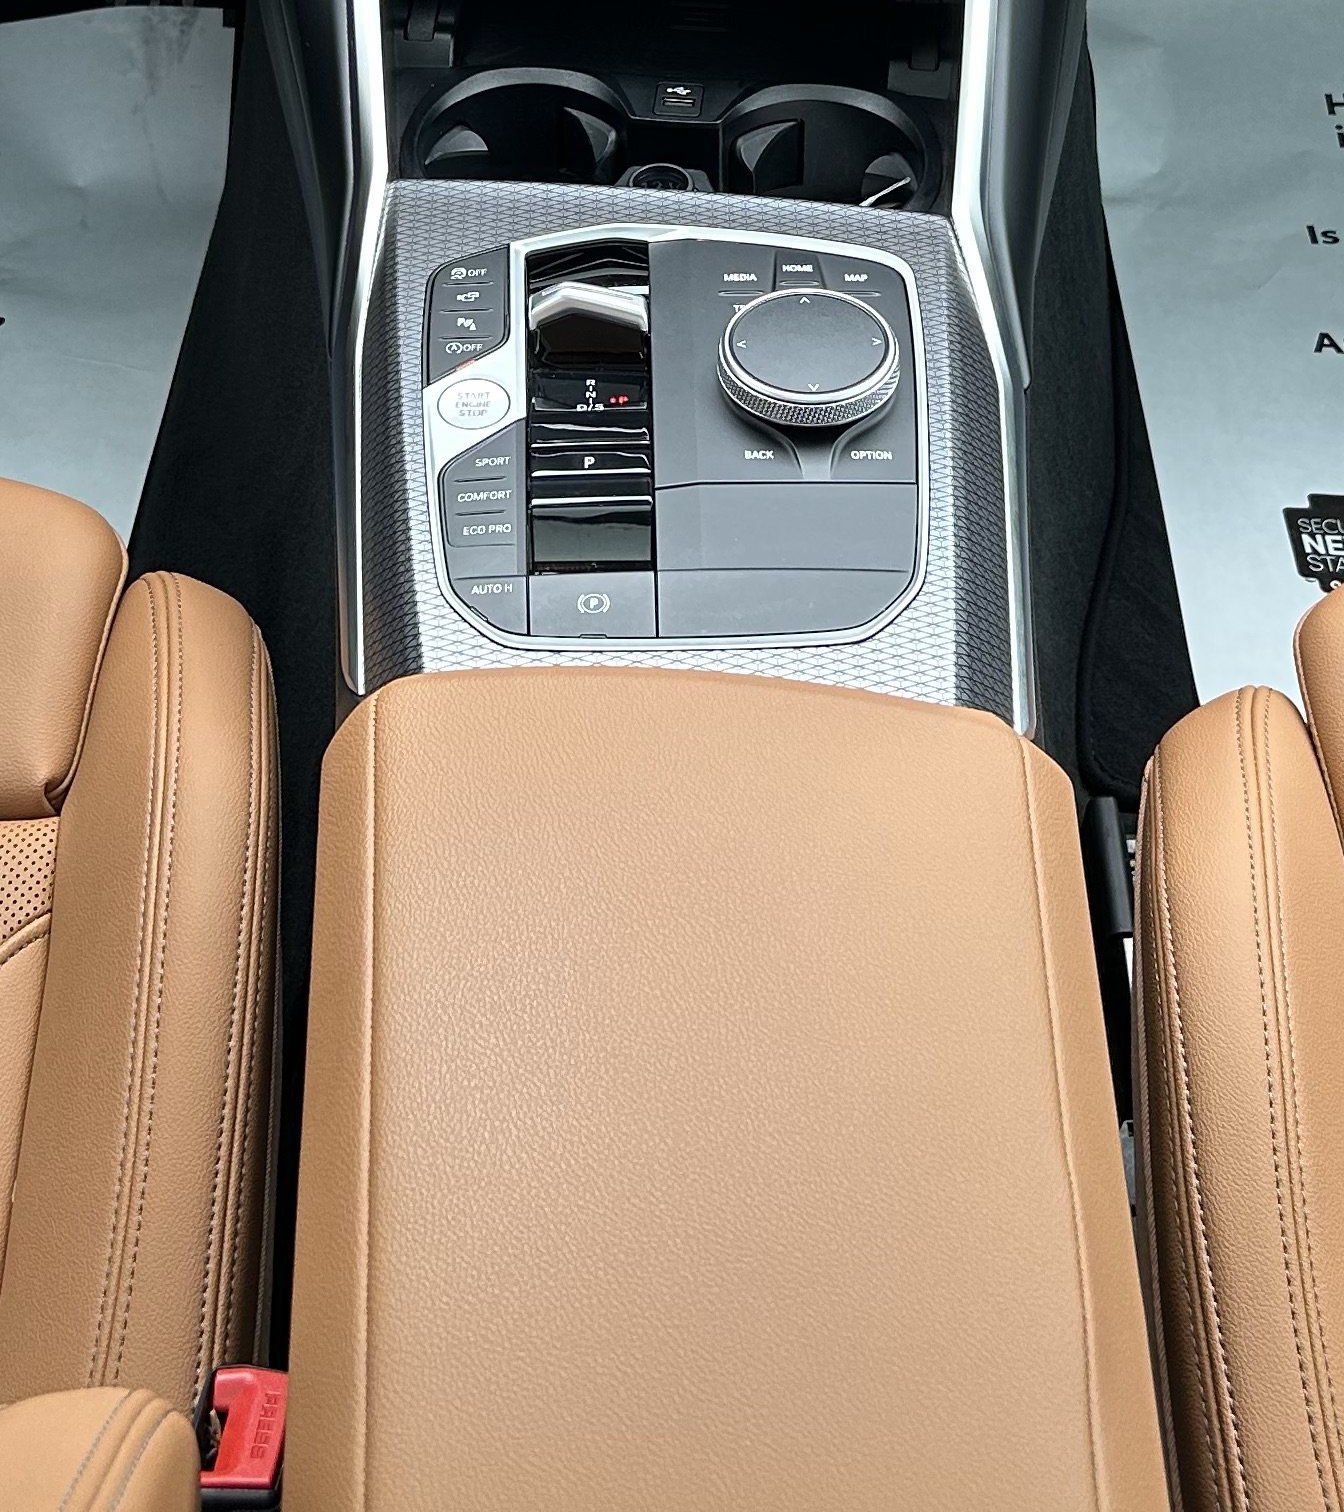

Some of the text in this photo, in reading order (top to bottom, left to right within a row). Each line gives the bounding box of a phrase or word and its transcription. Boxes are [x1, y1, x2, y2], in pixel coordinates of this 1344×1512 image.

[1306, 225, 1340, 245] Is
[468, 268, 488, 277] OFF
[782, 264, 813, 272] HOME
[723, 273, 757, 282] MEDIA
[844, 273, 868, 282] MAP
[463, 343, 483, 353] OFF
[459, 409, 487, 417] STOP
[744, 450, 774, 460] BACK
[851, 450, 893, 460] OPTION
[475, 456, 511, 467] SPORT
[584, 456, 595, 468] P
[457, 490, 512, 502] COMFORT
[463, 524, 512, 536] ECO PRO
[471, 584, 513, 595] AUTO H
